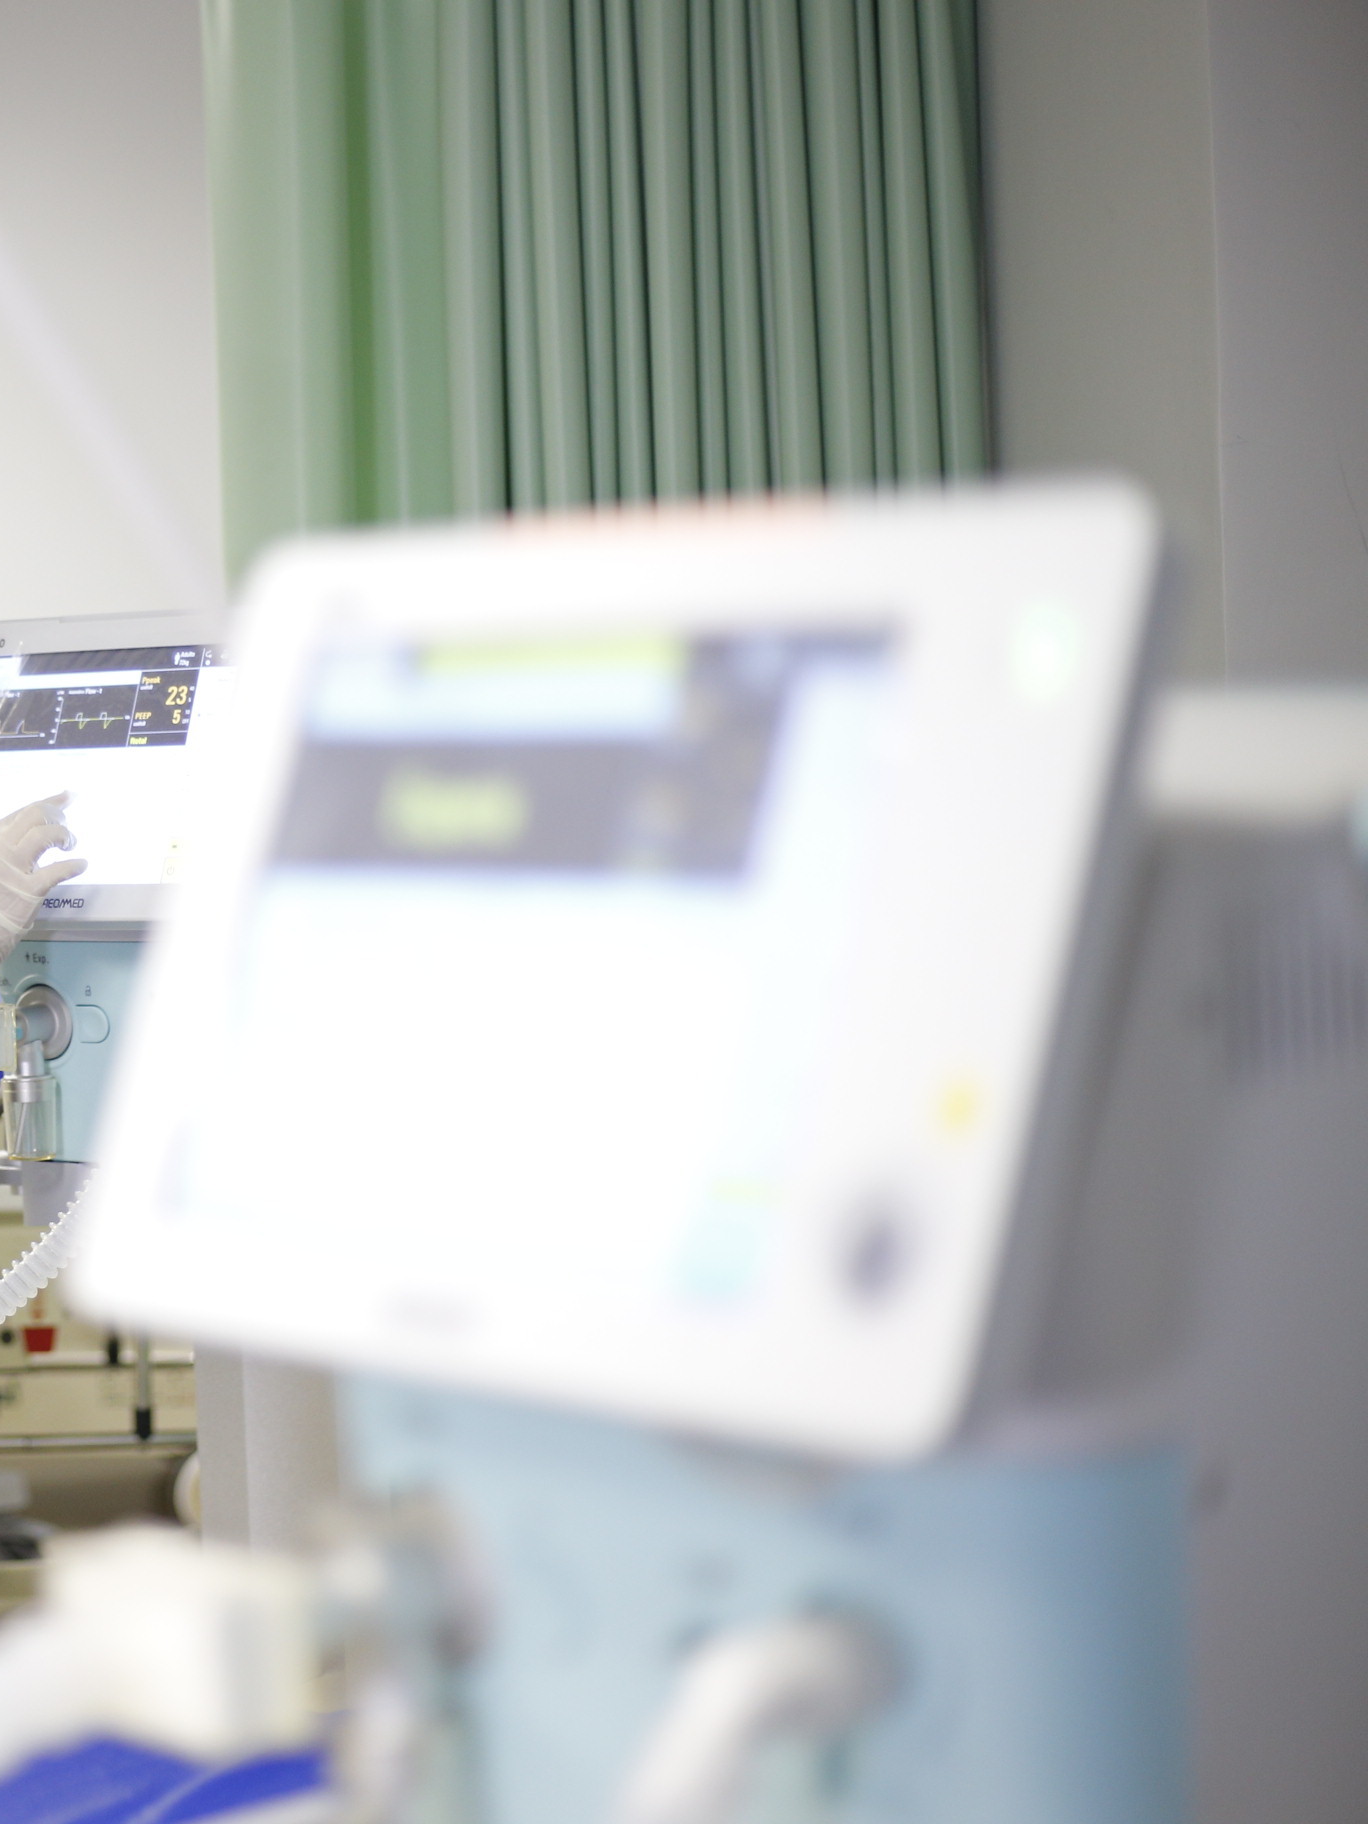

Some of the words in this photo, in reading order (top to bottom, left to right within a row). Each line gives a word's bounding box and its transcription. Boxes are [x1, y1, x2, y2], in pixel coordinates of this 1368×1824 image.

[165, 686, 188, 706] 23
[135, 711, 152, 720] PEEP
[172, 709, 181, 724] 5
